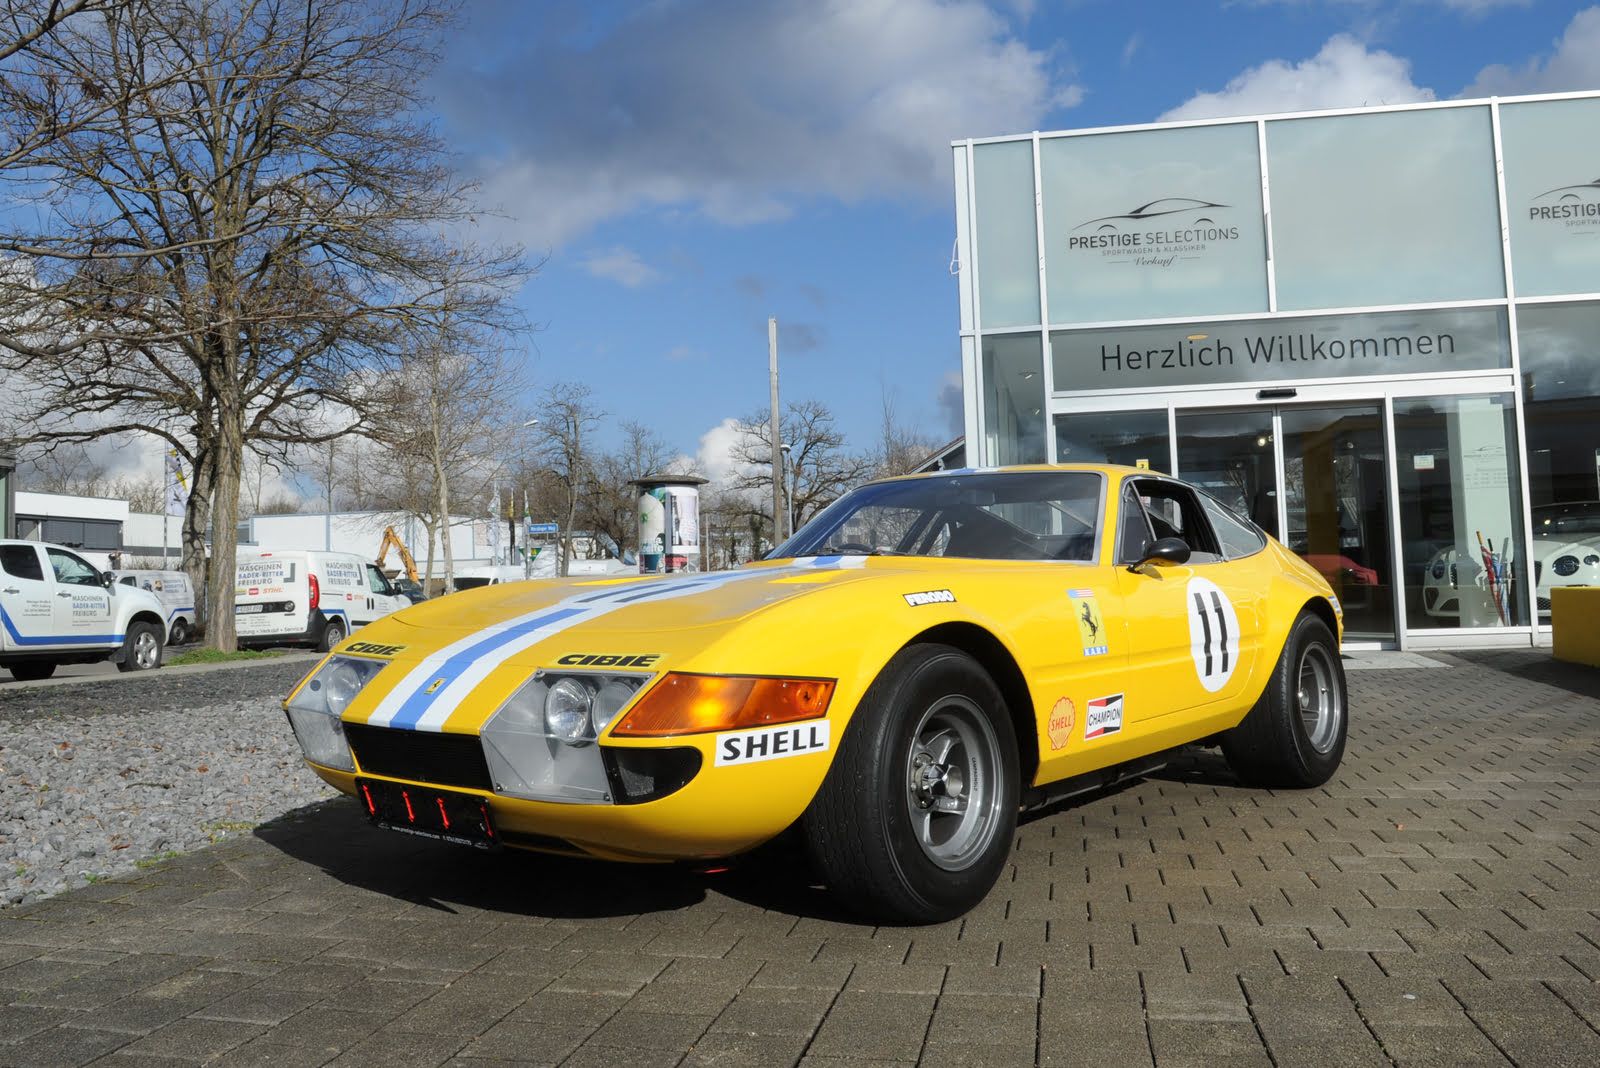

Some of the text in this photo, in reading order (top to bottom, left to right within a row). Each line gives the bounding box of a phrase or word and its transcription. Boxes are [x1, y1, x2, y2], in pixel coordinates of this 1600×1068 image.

[1529, 202, 1600, 220] PRESTIG
[1069, 227, 1239, 250] PRESTIGE SELECTIONS
[1102, 247, 1153, 256] SPORTWAGEN
[1163, 244, 1206, 253] KLASSIKER
[1134, 255, 1177, 267] Verkauf
[1101, 333, 1455, 371] Herzlich Willkommen
[238, 563, 282, 572] MASCHINEN
[238, 570, 284, 579] BADER-RITTER
[237, 578, 273, 586] FREIBURG
[904, 590, 956, 606] FERODO
[1192, 590, 1229, 678] 11
[1049, 715, 1072, 732] SHELL
[1088, 708, 1121, 727] CHAMPION
[722, 726, 824, 761] SHELL
